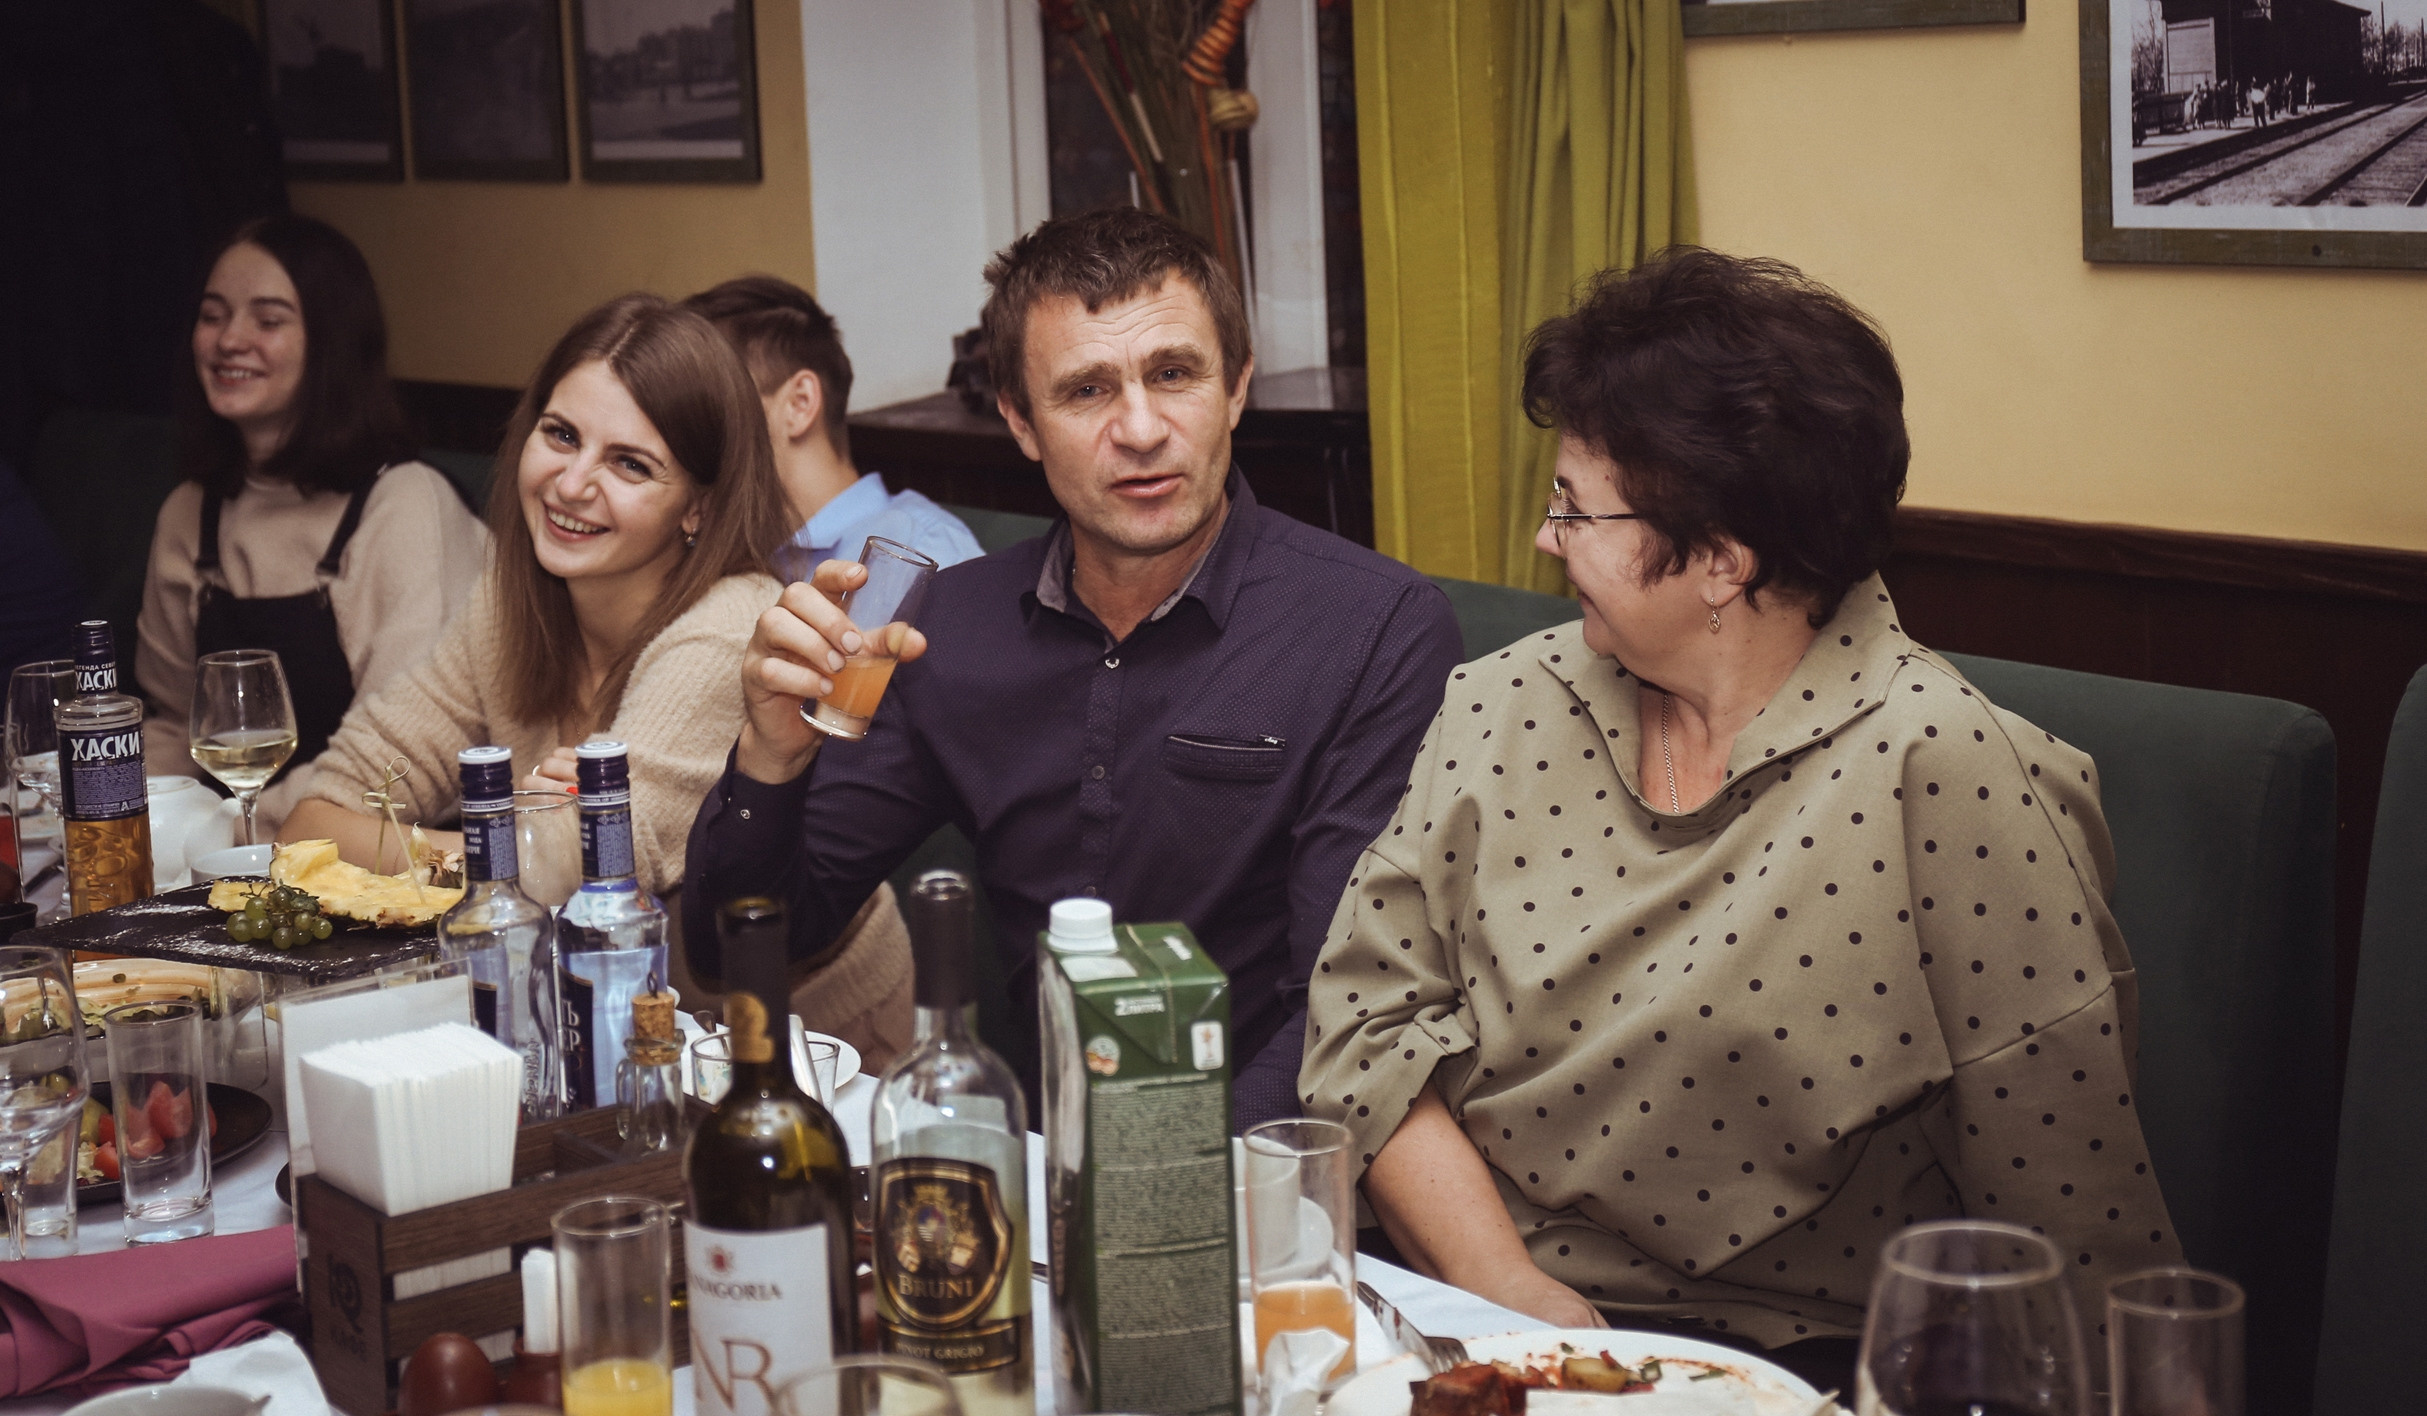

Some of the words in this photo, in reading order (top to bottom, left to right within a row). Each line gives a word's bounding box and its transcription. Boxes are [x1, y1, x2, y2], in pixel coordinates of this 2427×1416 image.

[70, 731, 140, 762] ХАСКИ
[1114, 997, 1126, 1016] 2
[898, 1273, 974, 1299] BRUNI
[933, 1345, 985, 1360] GRIGIO
